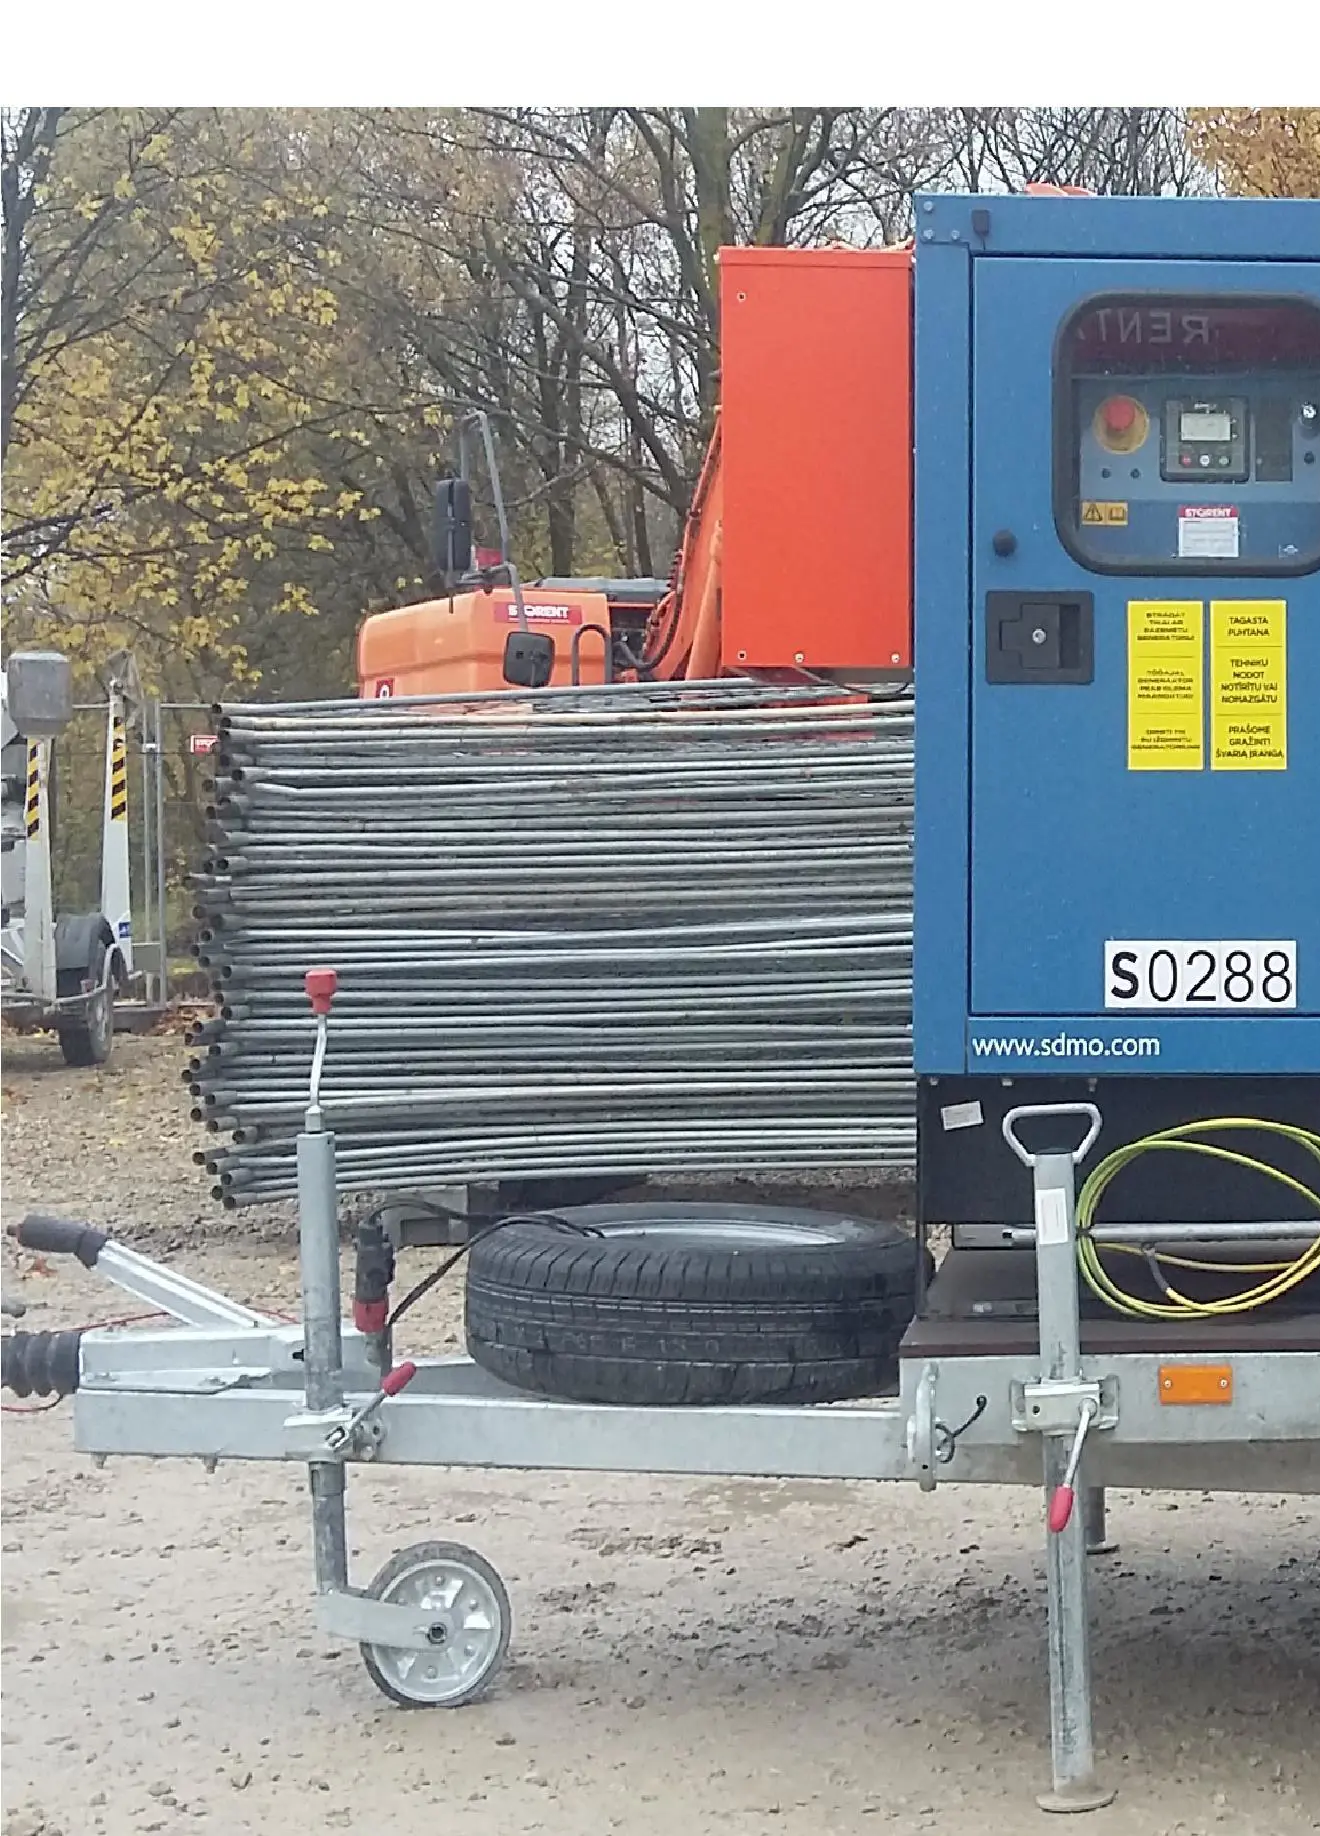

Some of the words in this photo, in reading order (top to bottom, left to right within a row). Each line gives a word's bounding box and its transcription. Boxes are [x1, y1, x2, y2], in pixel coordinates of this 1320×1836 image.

[508, 604, 569, 619] SORENT
[1228, 616, 1269, 625] TAGASTA
[1110, 949, 1293, 1002] S0288
[972, 1032, 1161, 1056] www.sdmo.com
